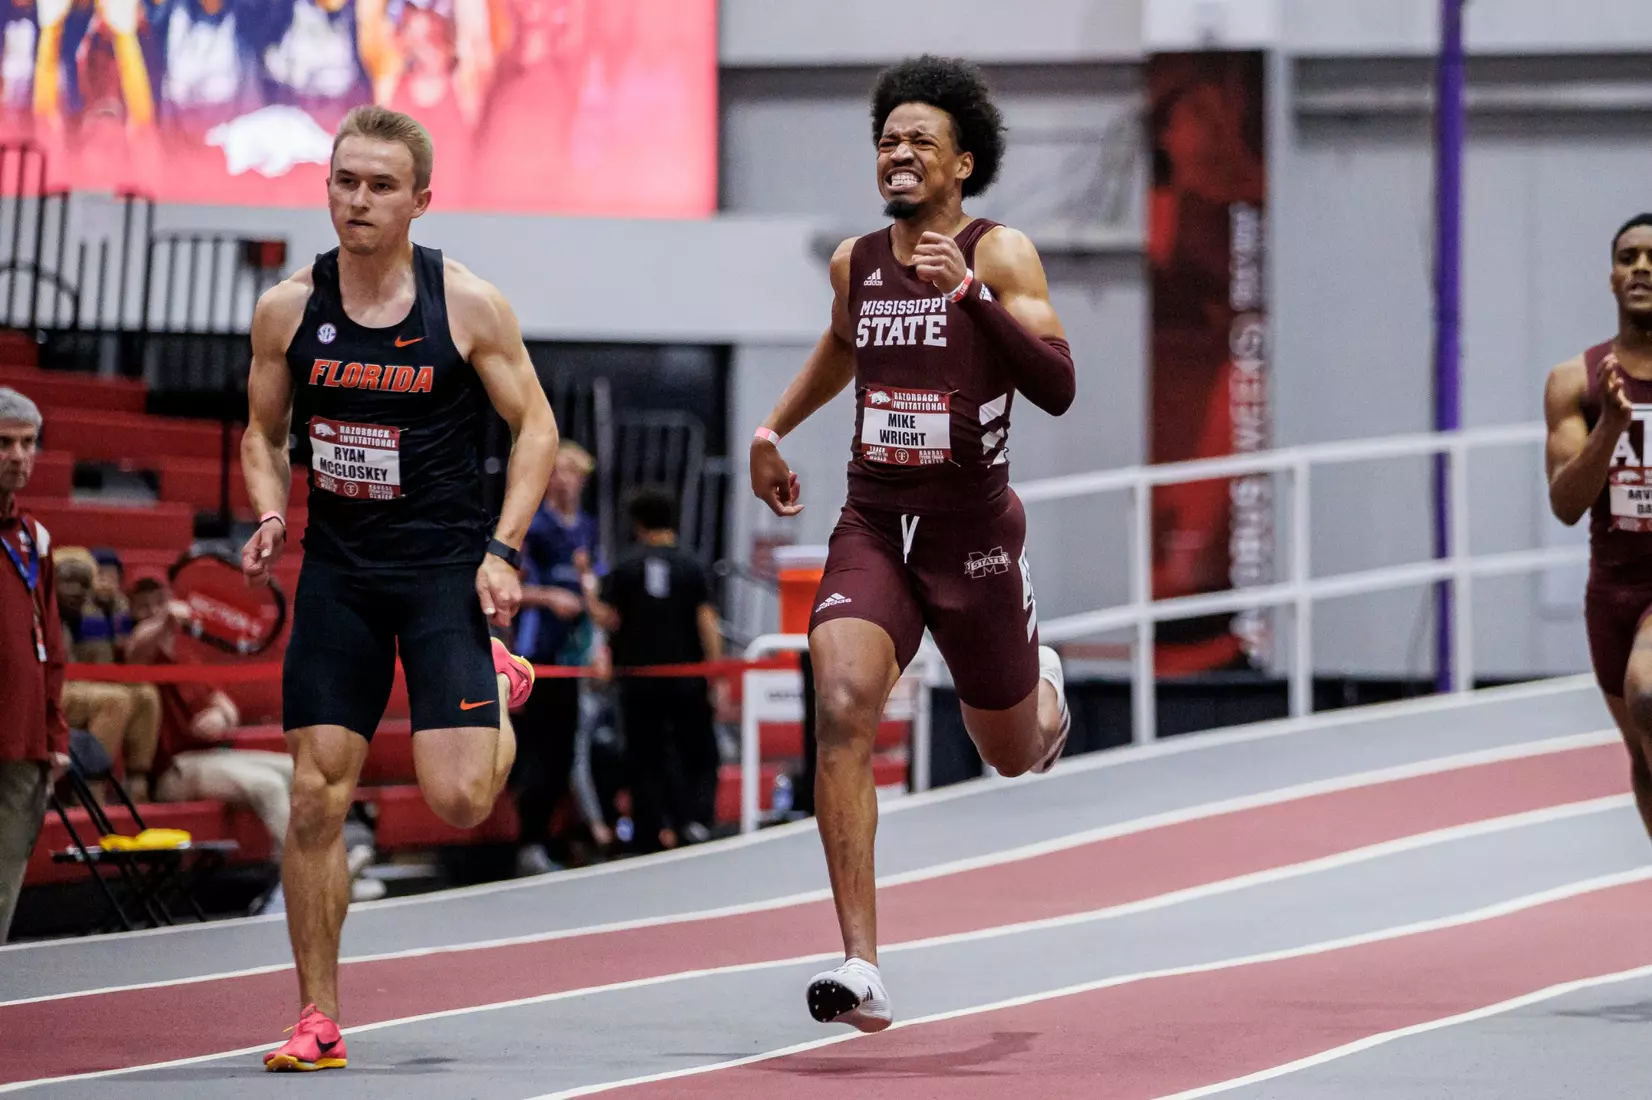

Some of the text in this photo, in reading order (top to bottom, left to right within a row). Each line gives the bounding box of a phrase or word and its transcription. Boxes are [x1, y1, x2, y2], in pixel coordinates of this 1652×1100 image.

[860, 298, 947, 316] MISSISSIPPI
[855, 315, 947, 348] STATE
[308, 359, 434, 393] FLORIDA
[894, 392, 939, 402] RAZORBACK
[893, 401, 946, 411] INVITATIONAL
[887, 413, 916, 429] MIKE
[339, 425, 390, 438] RAZORBACK
[879, 429, 926, 447] WRIGHT
[339, 435, 396, 448] INVITATIONAL
[334, 446, 366, 463] RYAN
[319, 457, 388, 482] MCCLOSKEY
[973, 556, 1003, 569] STATE
